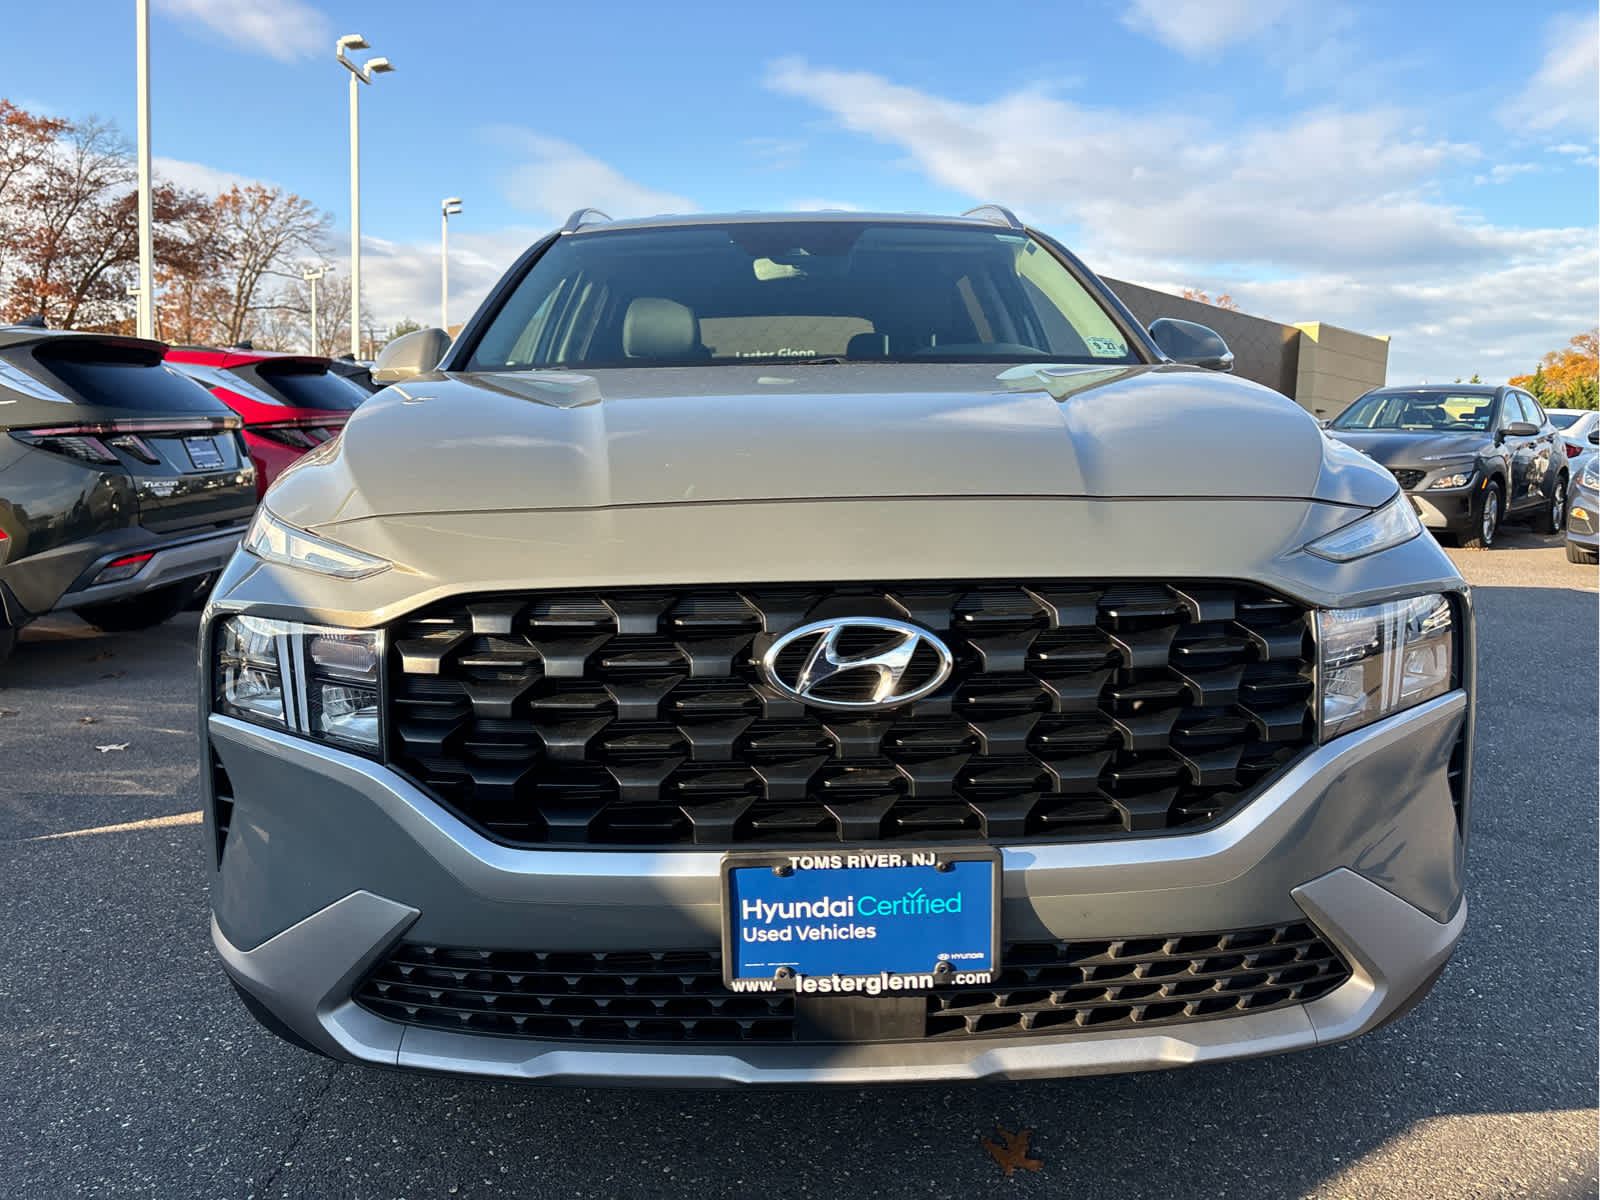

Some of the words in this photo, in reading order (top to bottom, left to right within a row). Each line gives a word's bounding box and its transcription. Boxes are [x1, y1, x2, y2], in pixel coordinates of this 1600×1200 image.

[788, 855, 843, 870] TOMS
[847, 854, 907, 868] RIVER,
[911, 852, 936, 867] NJ
[741, 895, 854, 924] Hyundai
[857, 888, 963, 916] Certified
[743, 925, 792, 942] Used
[796, 923, 877, 941] Vehicles
